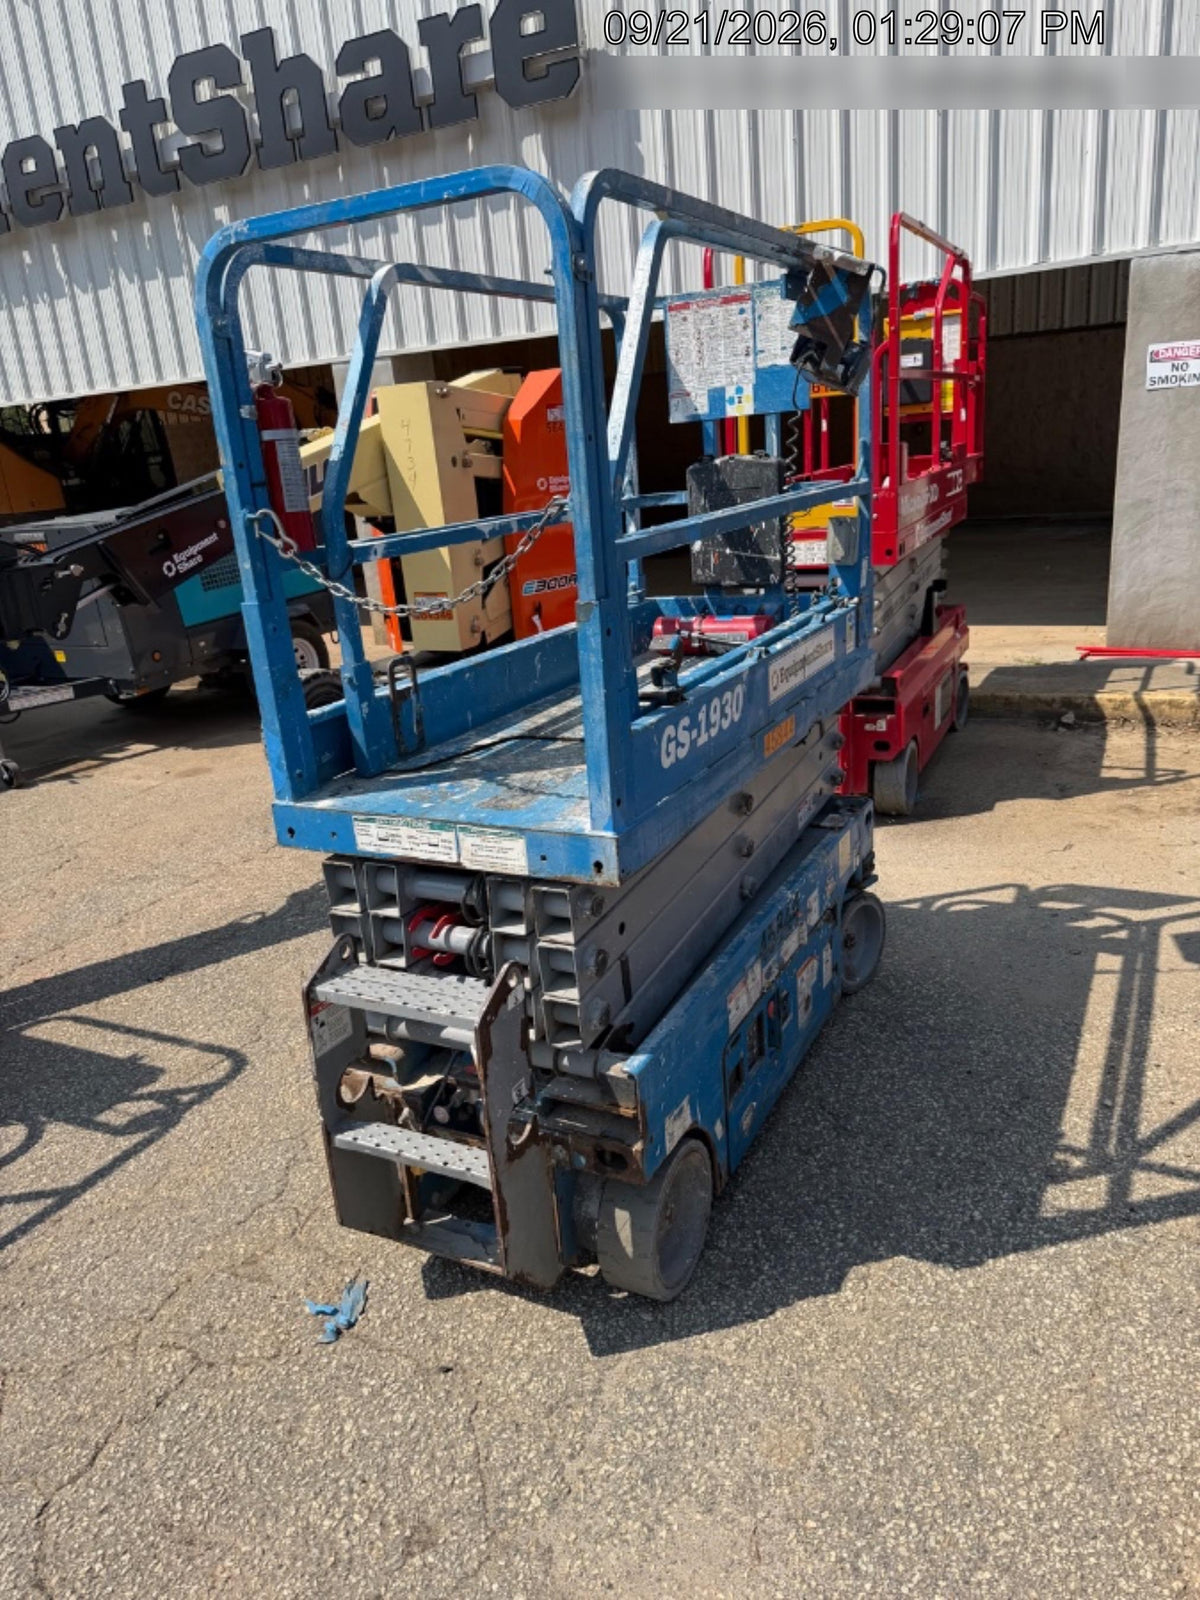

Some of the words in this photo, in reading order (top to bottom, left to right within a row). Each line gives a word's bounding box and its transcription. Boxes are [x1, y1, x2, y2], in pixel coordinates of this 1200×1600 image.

[0, 0, 581, 234] entShare
[1149, 373, 1200, 387] SMOKIN
[1171, 362, 1190, 373] NO
[167, 390, 211, 415] CAS
[172, 532, 219, 564] Equipment
[660, 683, 743, 769] GS-1930
